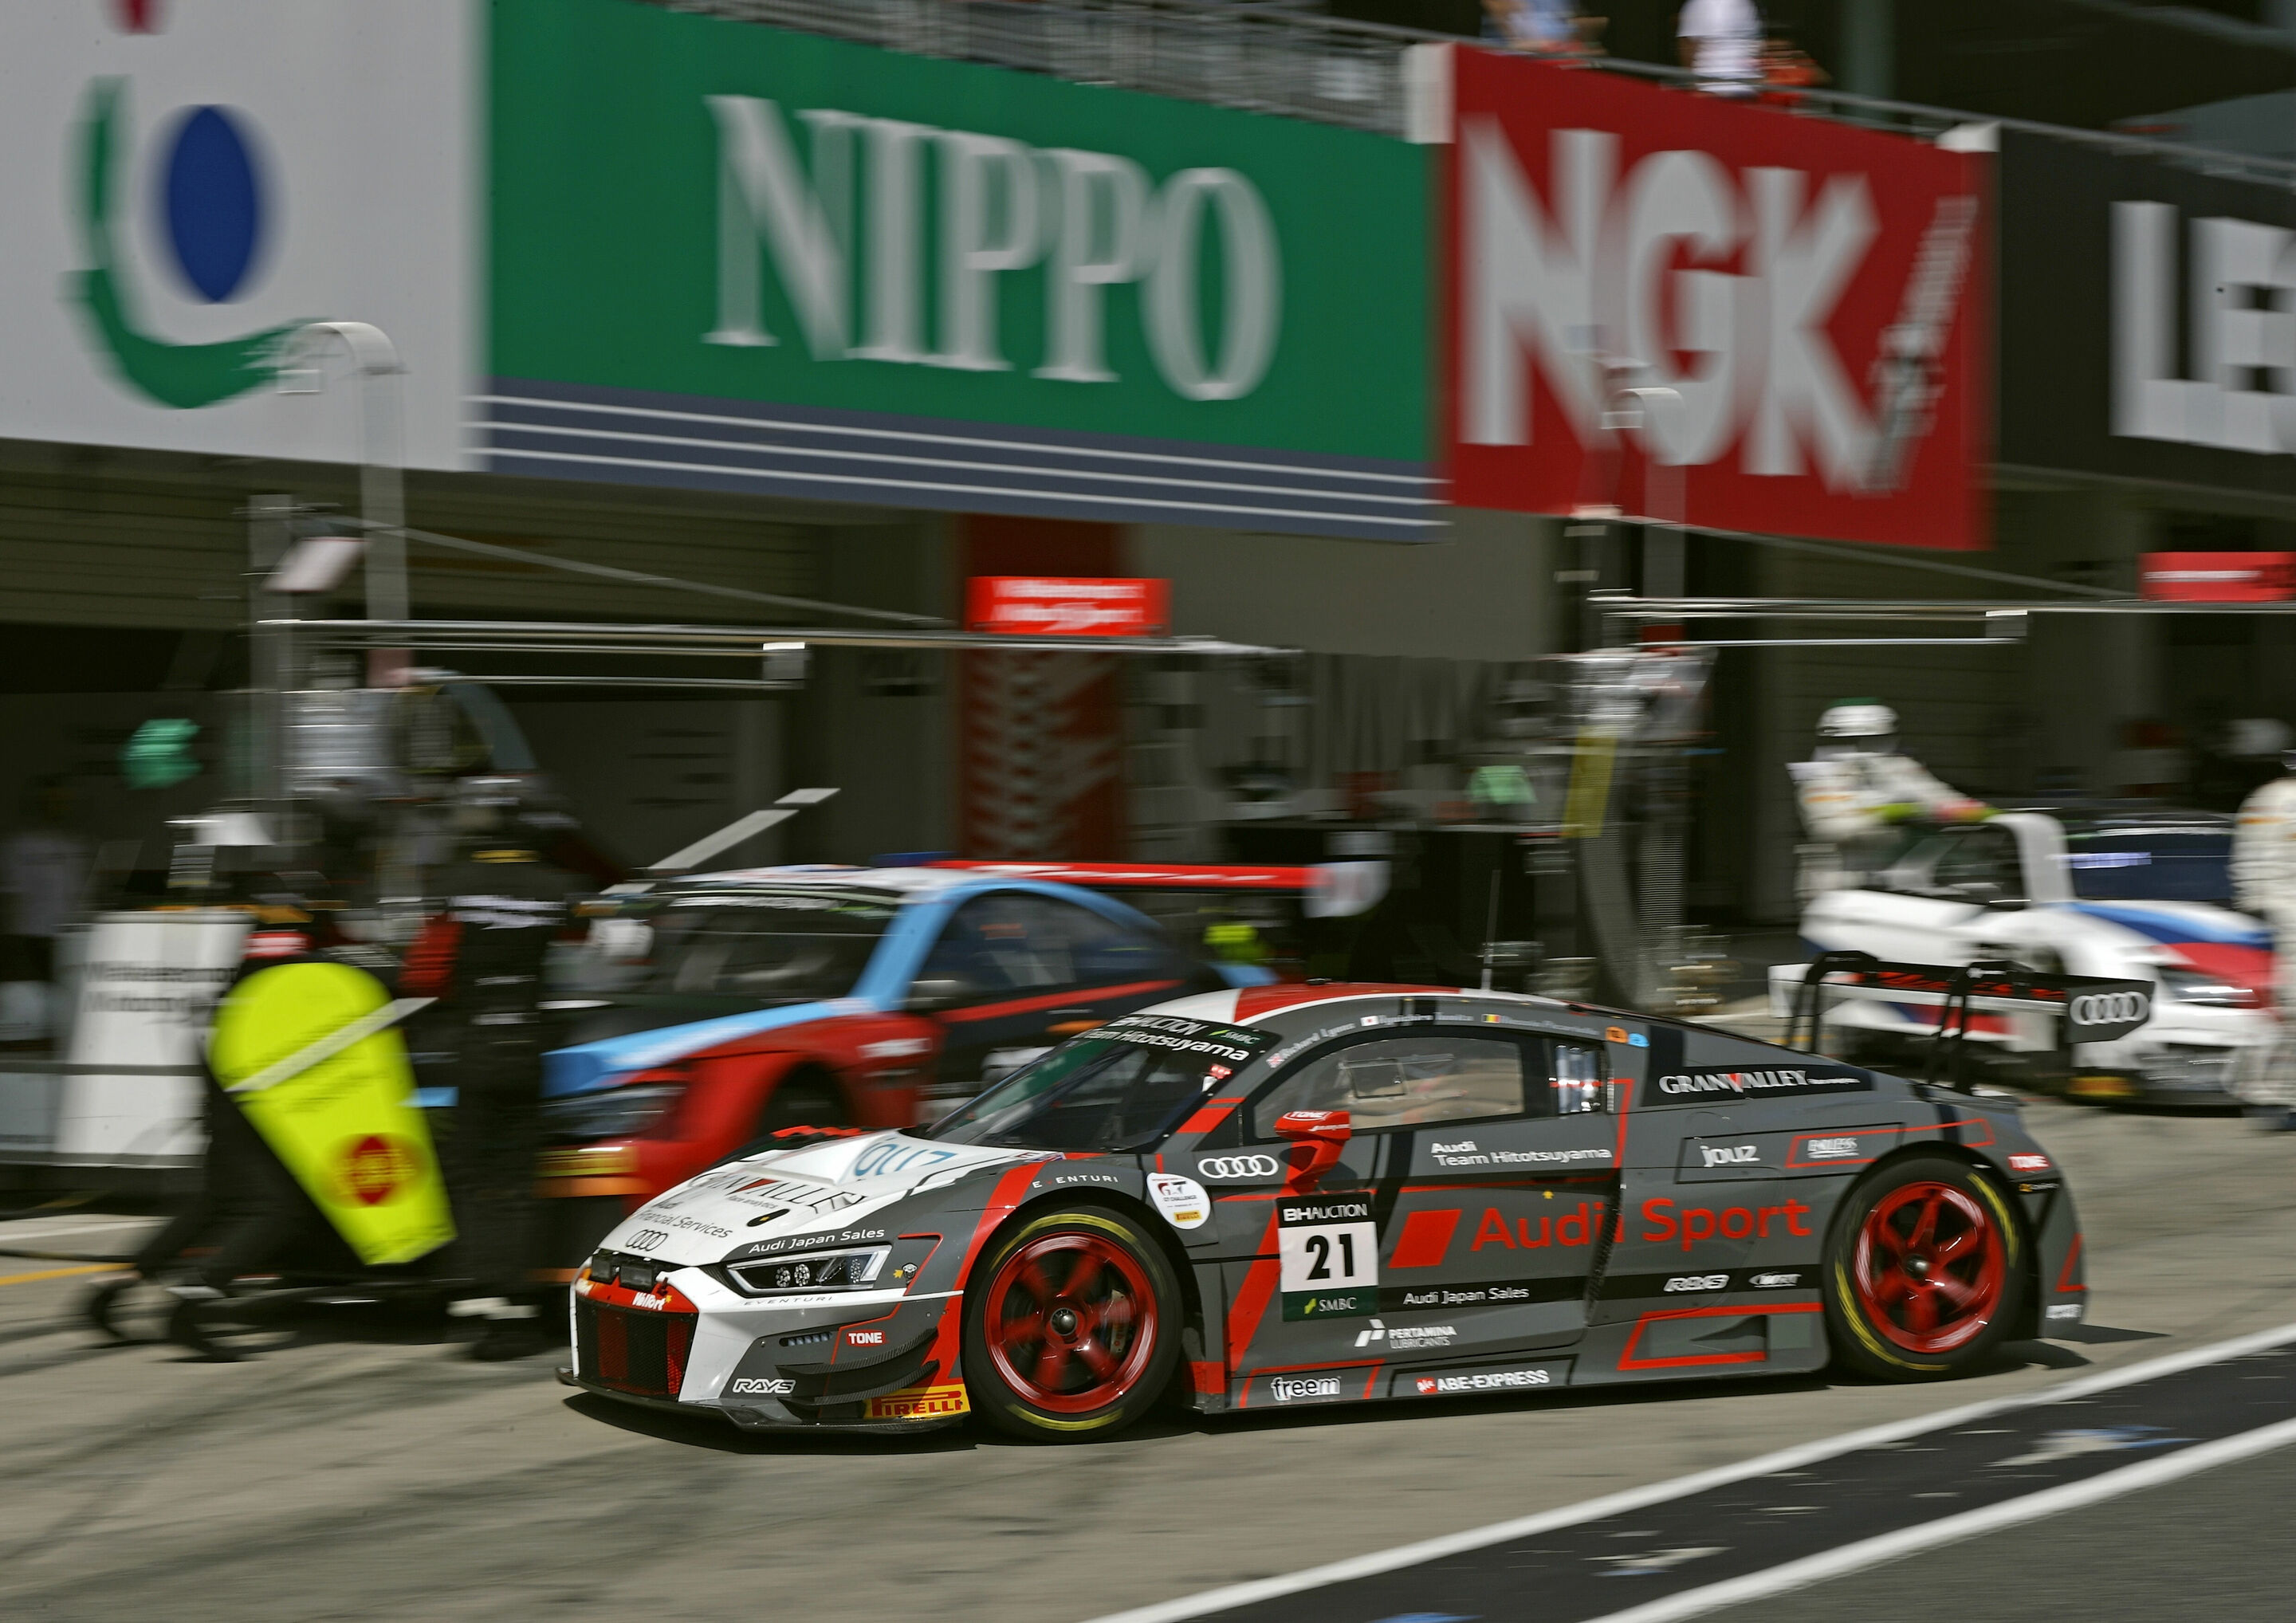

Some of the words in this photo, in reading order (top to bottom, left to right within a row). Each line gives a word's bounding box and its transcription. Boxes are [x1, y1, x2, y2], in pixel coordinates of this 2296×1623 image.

[702, 94, 1284, 402] NIPPO
[1457, 112, 1883, 496] NGK
[2109, 199, 2296, 454] LE
[1431, 1141, 1477, 1153] Audi
[1433, 1154, 1489, 1166] Team
[1489, 1149, 1612, 1163] Hitotsuyama
[672, 1216, 733, 1238] Services
[1470, 1202, 1624, 1252] Audi
[1641, 1197, 1813, 1252] Sport
[749, 1240, 785, 1254] Audi
[788, 1235, 835, 1249] Japan
[840, 1229, 885, 1241] Sales
[1306, 1233, 1354, 1281] 21
[1319, 1297, 1357, 1312] SMBC
[1403, 1291, 1438, 1305] Audi
[1441, 1289, 1486, 1304] Japan
[1488, 1287, 1529, 1299] Sales
[848, 1331, 883, 1344] TONE
[733, 1378, 796, 1393] RAYS
[1271, 1377, 1341, 1401] freem
[1437, 1370, 1550, 1391] ABE-EXPRESS
[871, 1390, 962, 1417] PIRELLI
